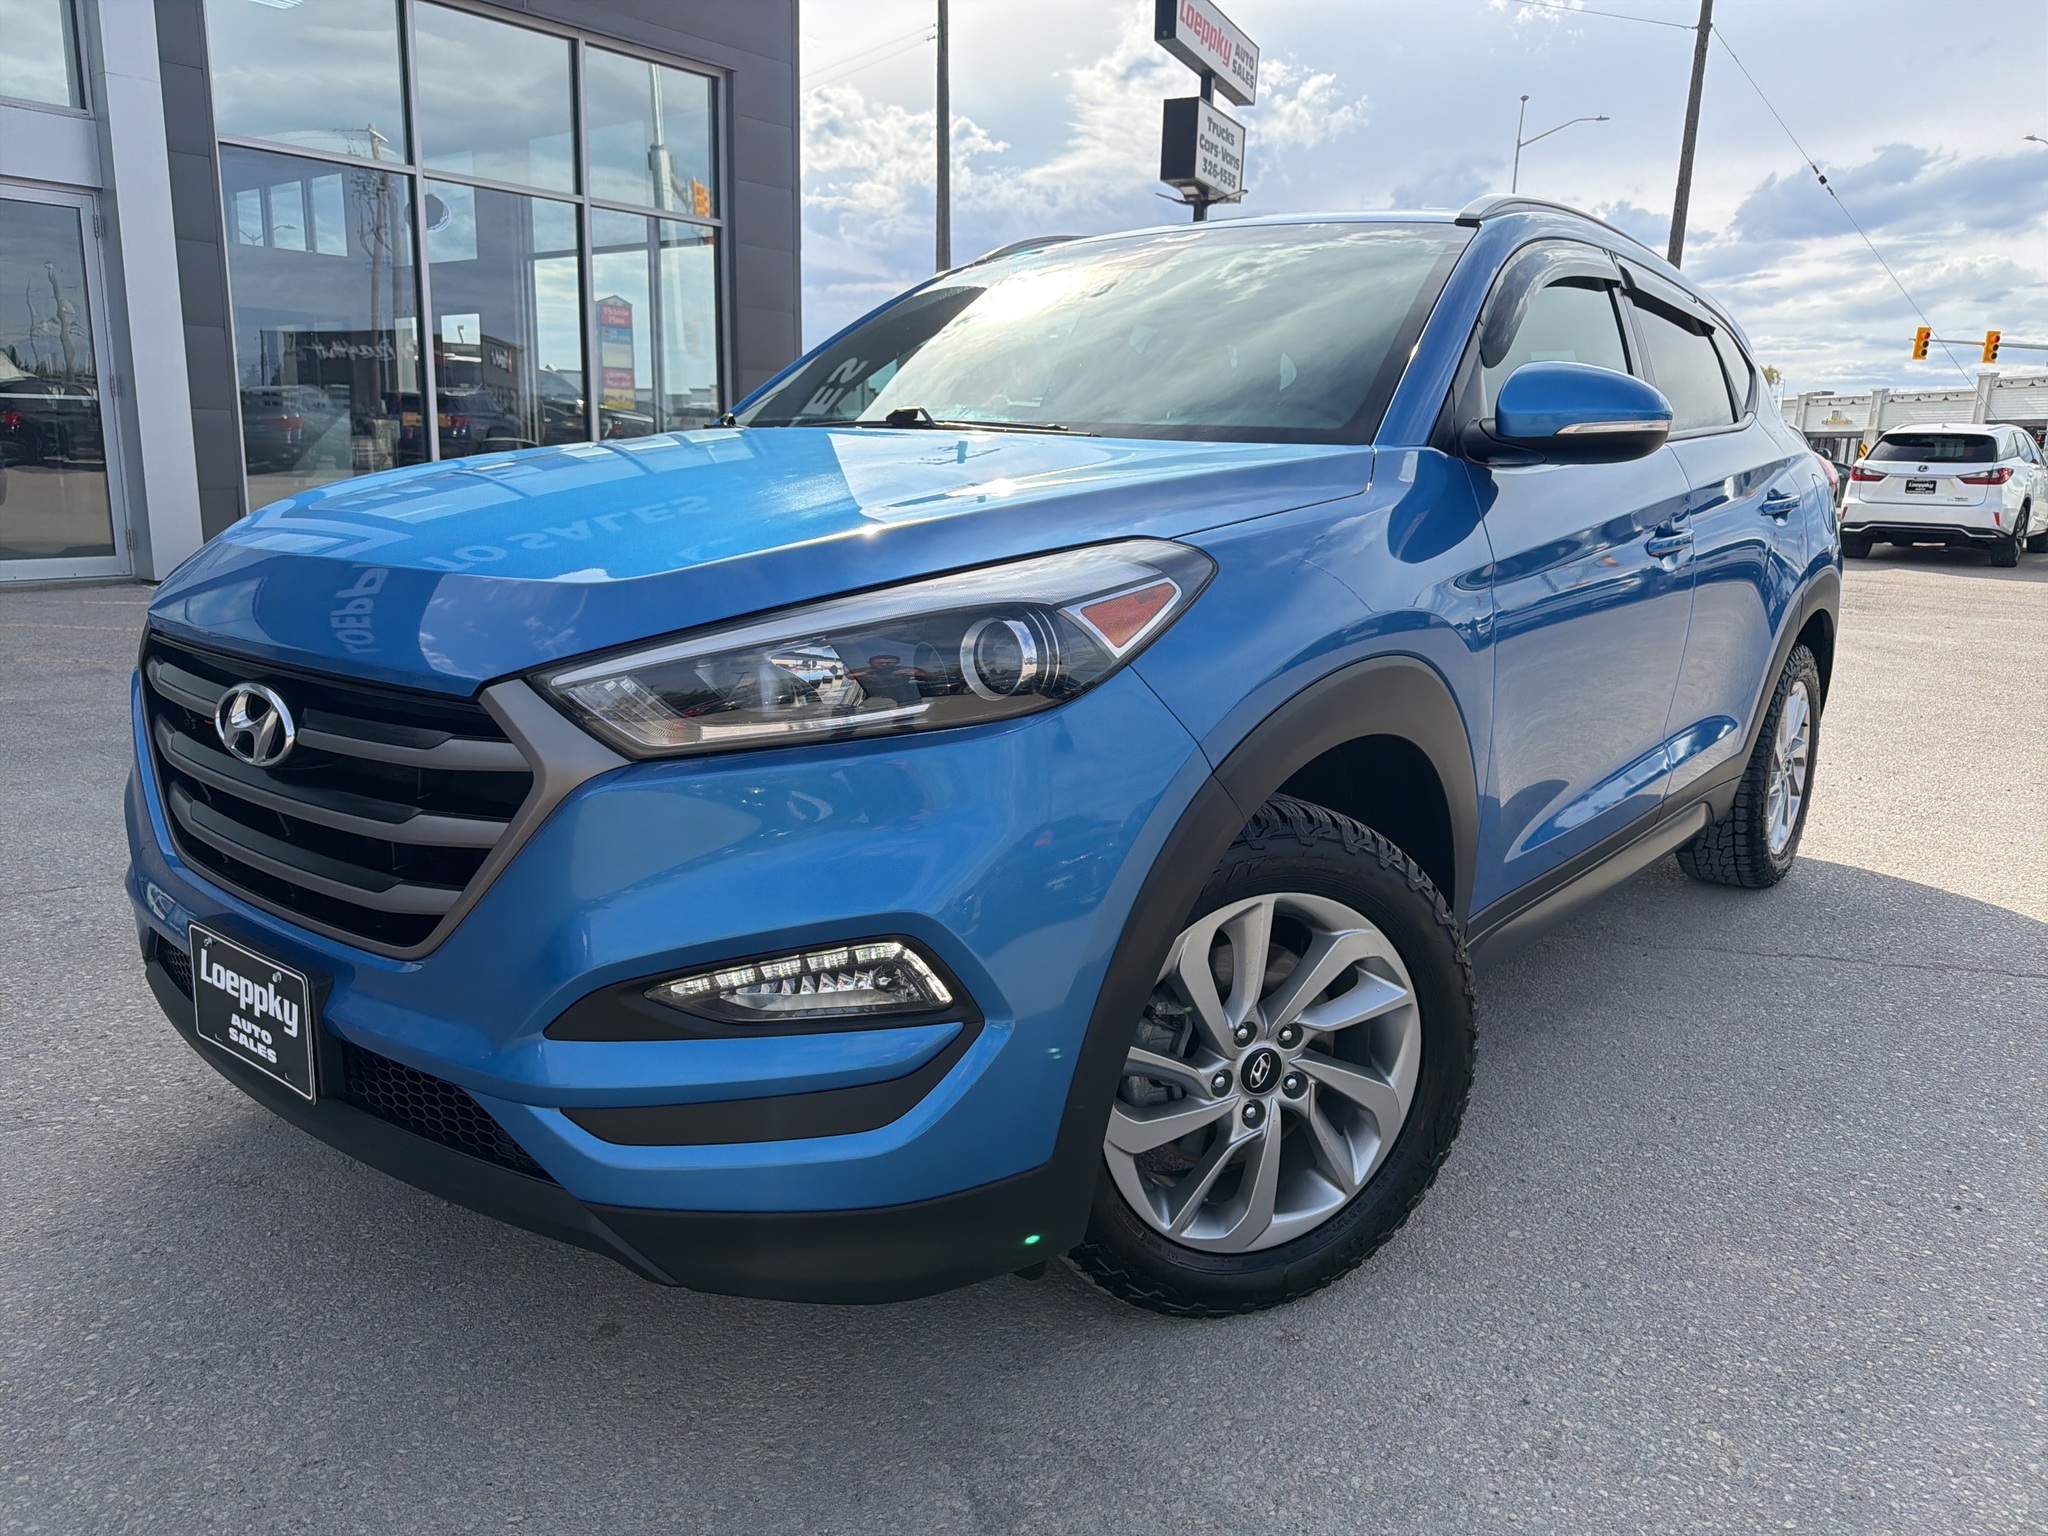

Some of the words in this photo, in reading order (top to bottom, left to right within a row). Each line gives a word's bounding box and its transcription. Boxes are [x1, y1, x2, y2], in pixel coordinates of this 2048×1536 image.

[1179, 0, 1232, 68] Loeppky
[1234, 42, 1255, 70] AUTO
[1231, 59, 1255, 90] SALES
[1207, 116, 1235, 146] Trucks
[1202, 157, 1237, 189] 326-1555
[200, 948, 299, 1038] Loeppky
[231, 1012, 273, 1045] AUTO
[228, 1029, 278, 1064] SALES
